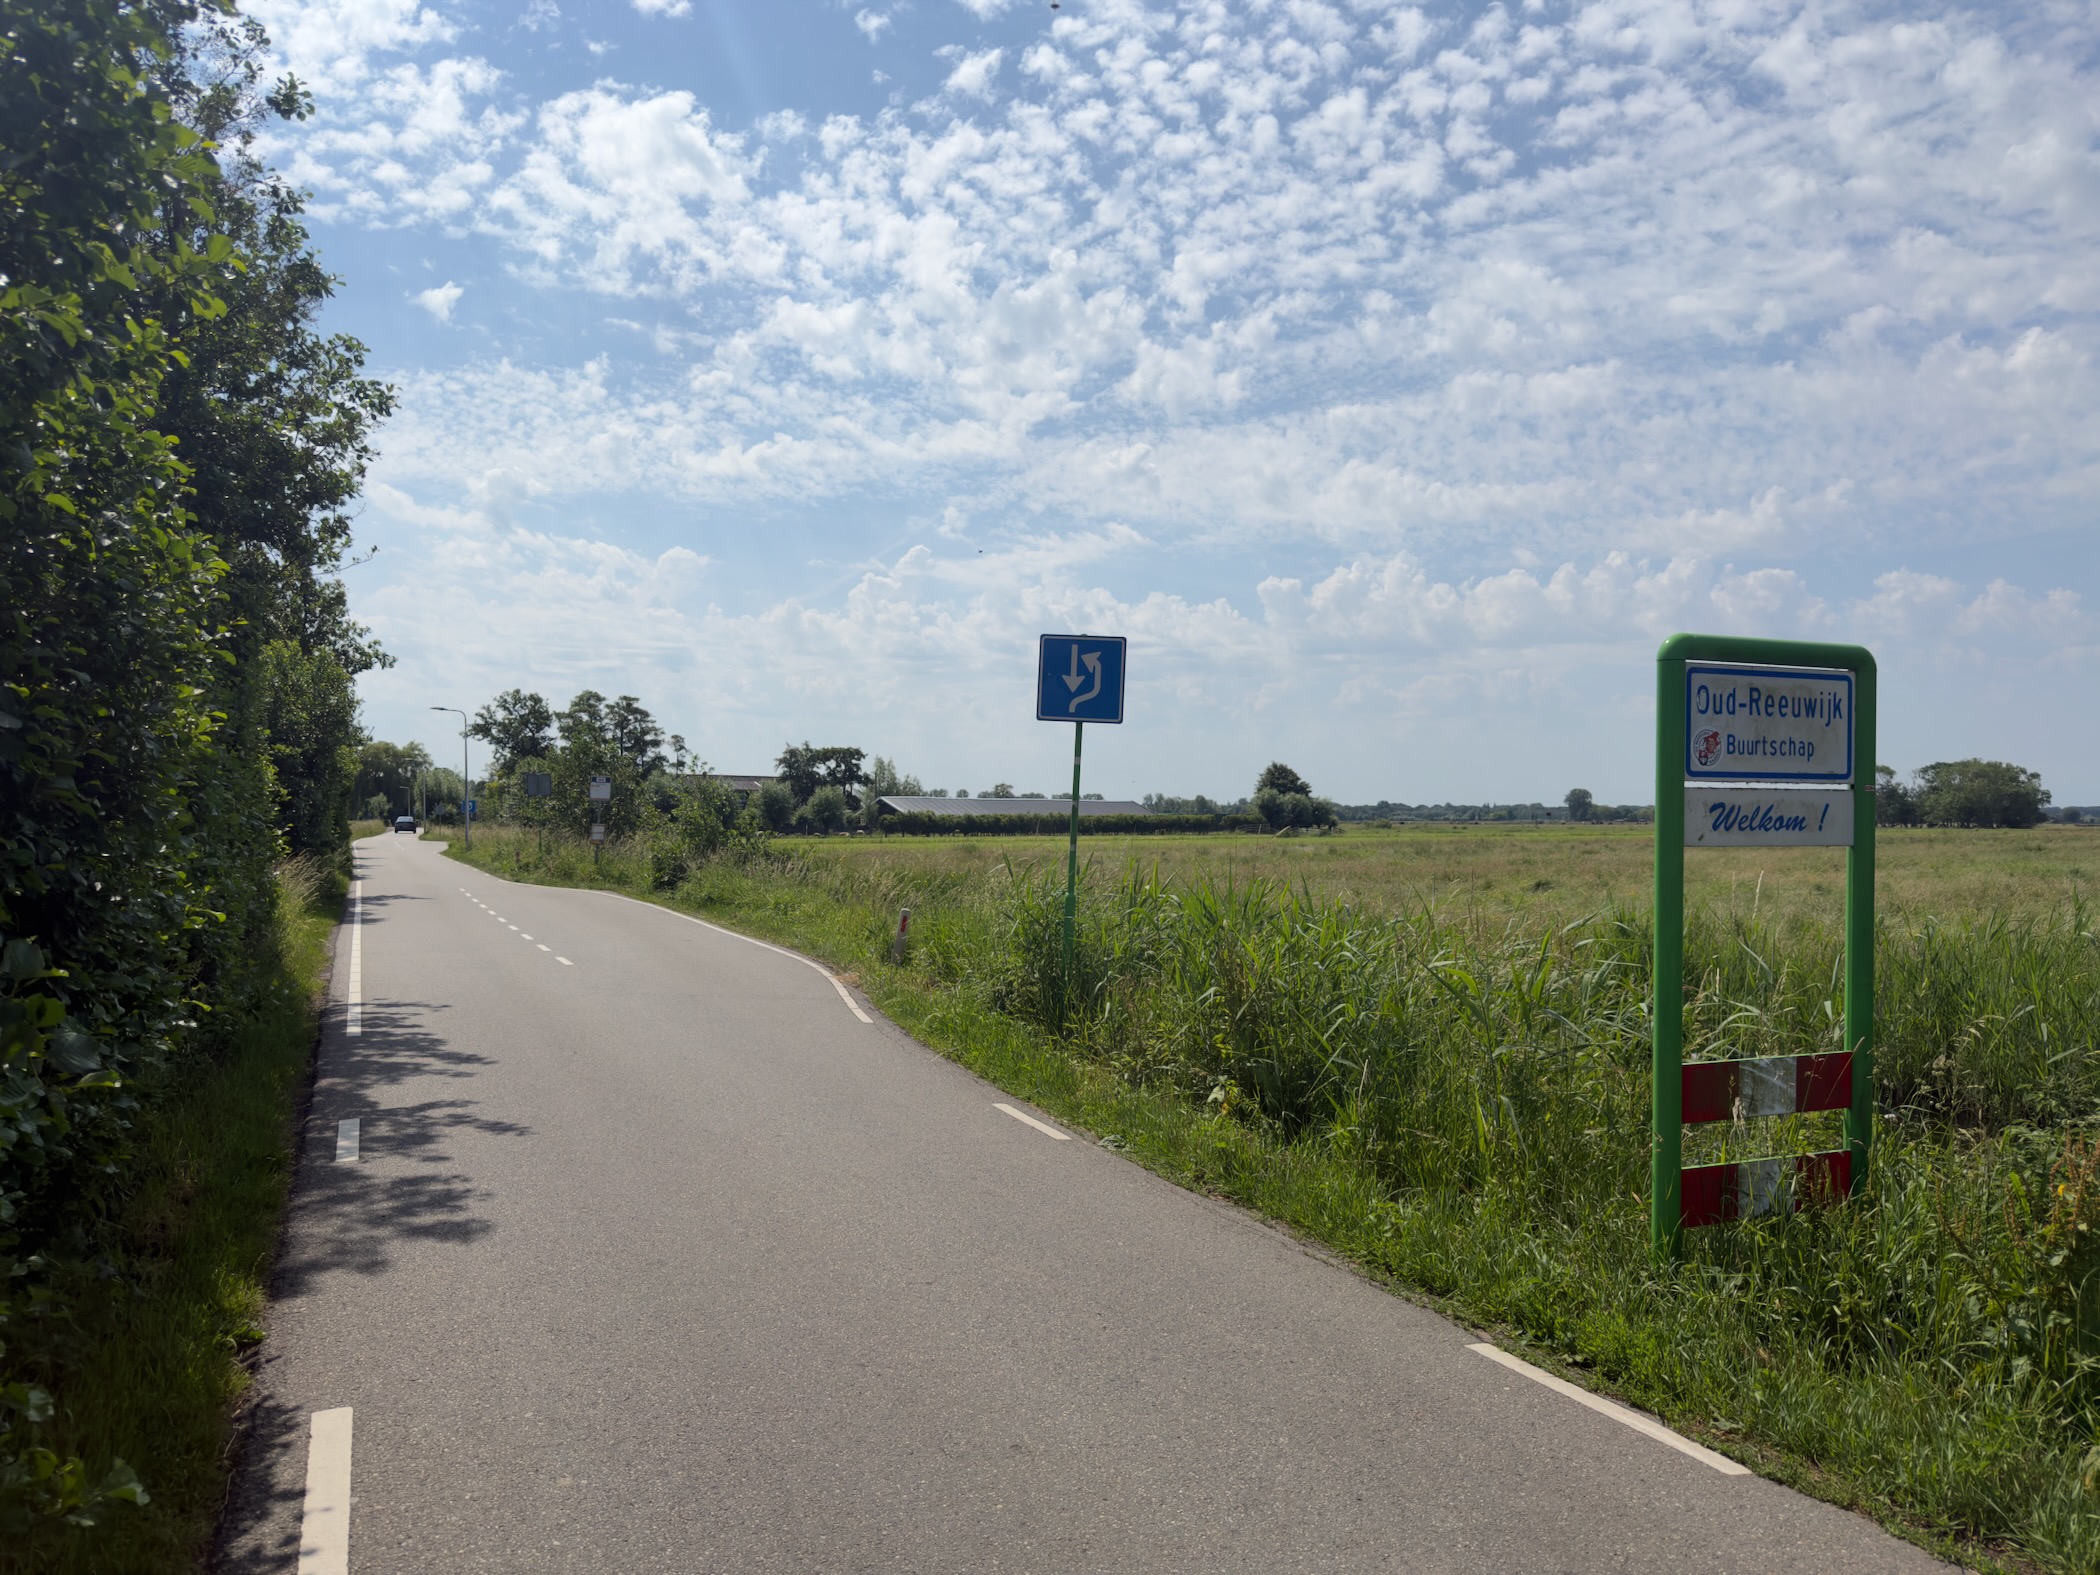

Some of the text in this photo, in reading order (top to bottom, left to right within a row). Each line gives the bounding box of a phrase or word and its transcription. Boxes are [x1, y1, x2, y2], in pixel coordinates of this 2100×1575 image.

[1697, 684, 1843, 727] Oud-Reeuwijk
[1726, 734, 1815, 761] Buurtschap
[1708, 802, 1808, 832] Welkom
